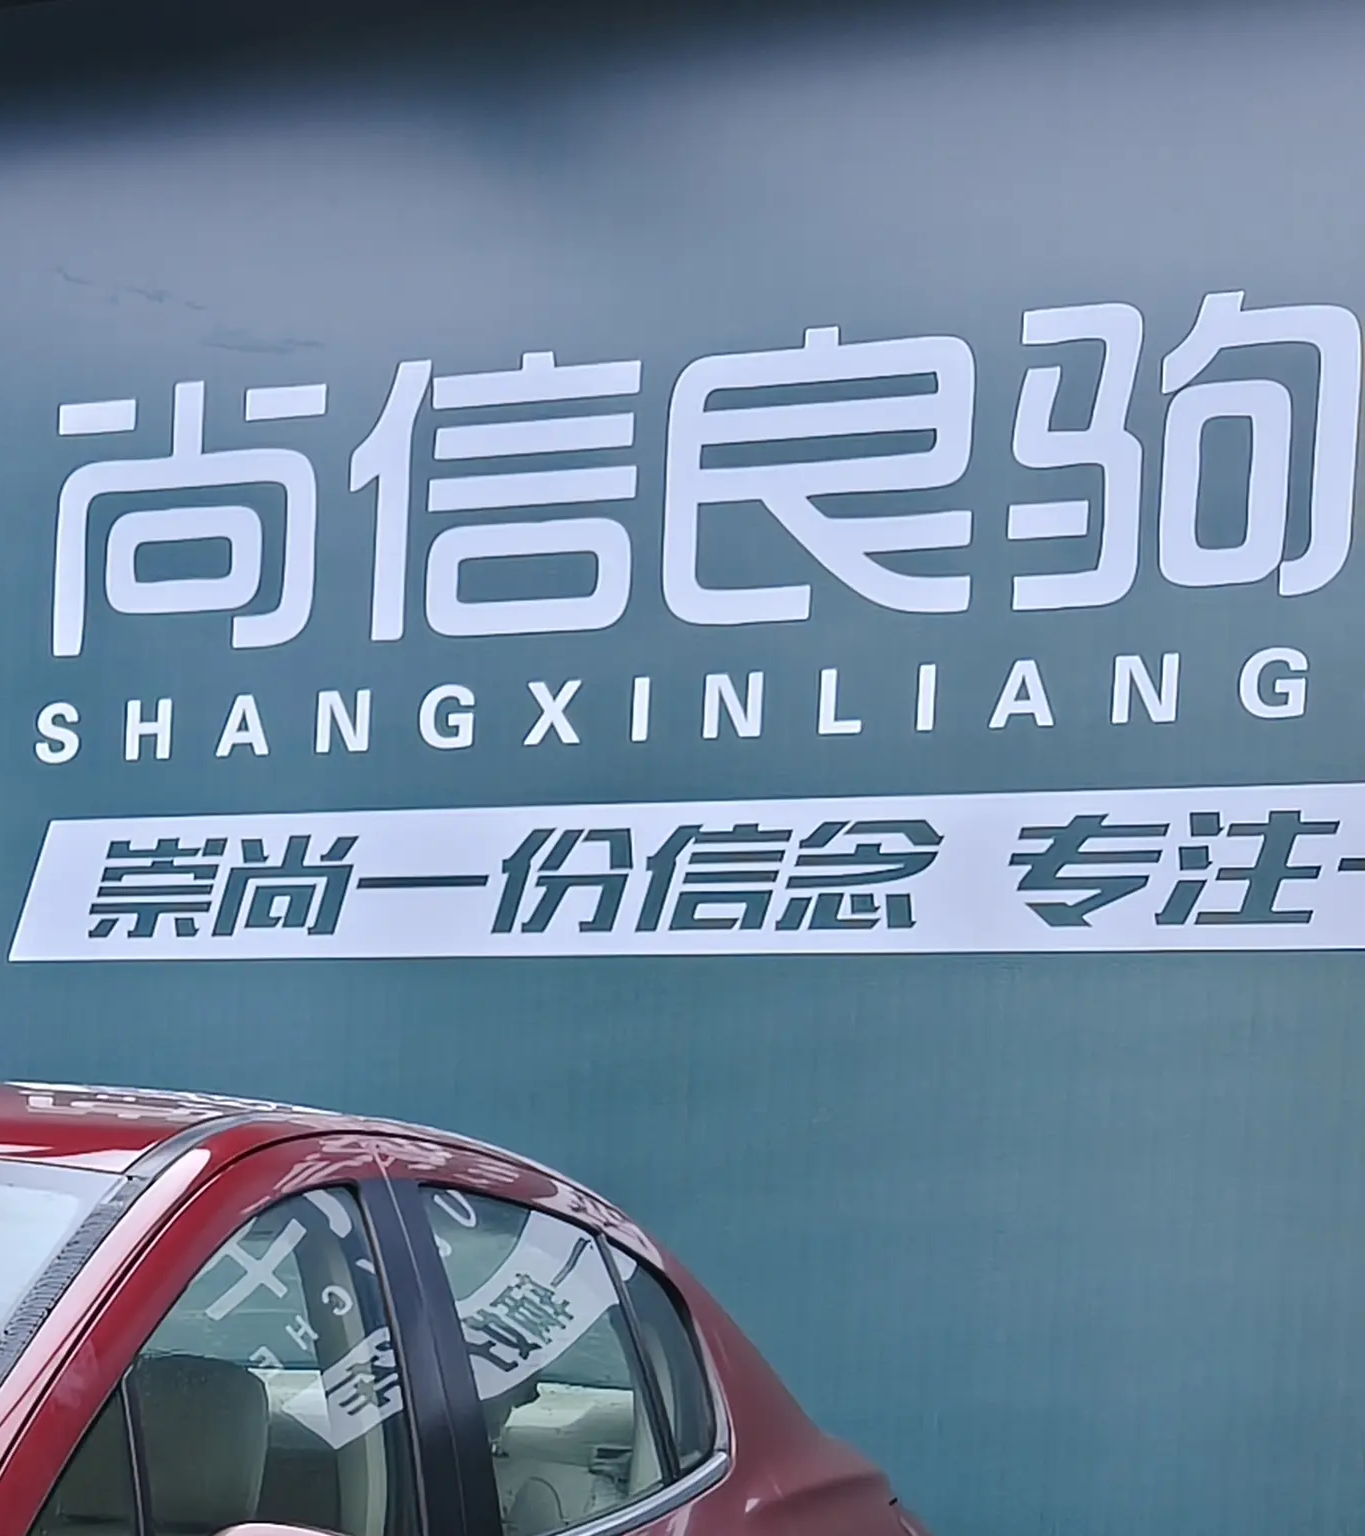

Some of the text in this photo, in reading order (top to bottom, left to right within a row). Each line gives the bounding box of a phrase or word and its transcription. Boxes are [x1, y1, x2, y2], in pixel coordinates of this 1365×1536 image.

[51, 290, 1362, 657] 尚信良驹
[32, 646, 1310, 765] SHANGXINLIANG
[87, 817, 945, 938] 崇尚一份信念
[1006, 808, 1365, 928] 专注
